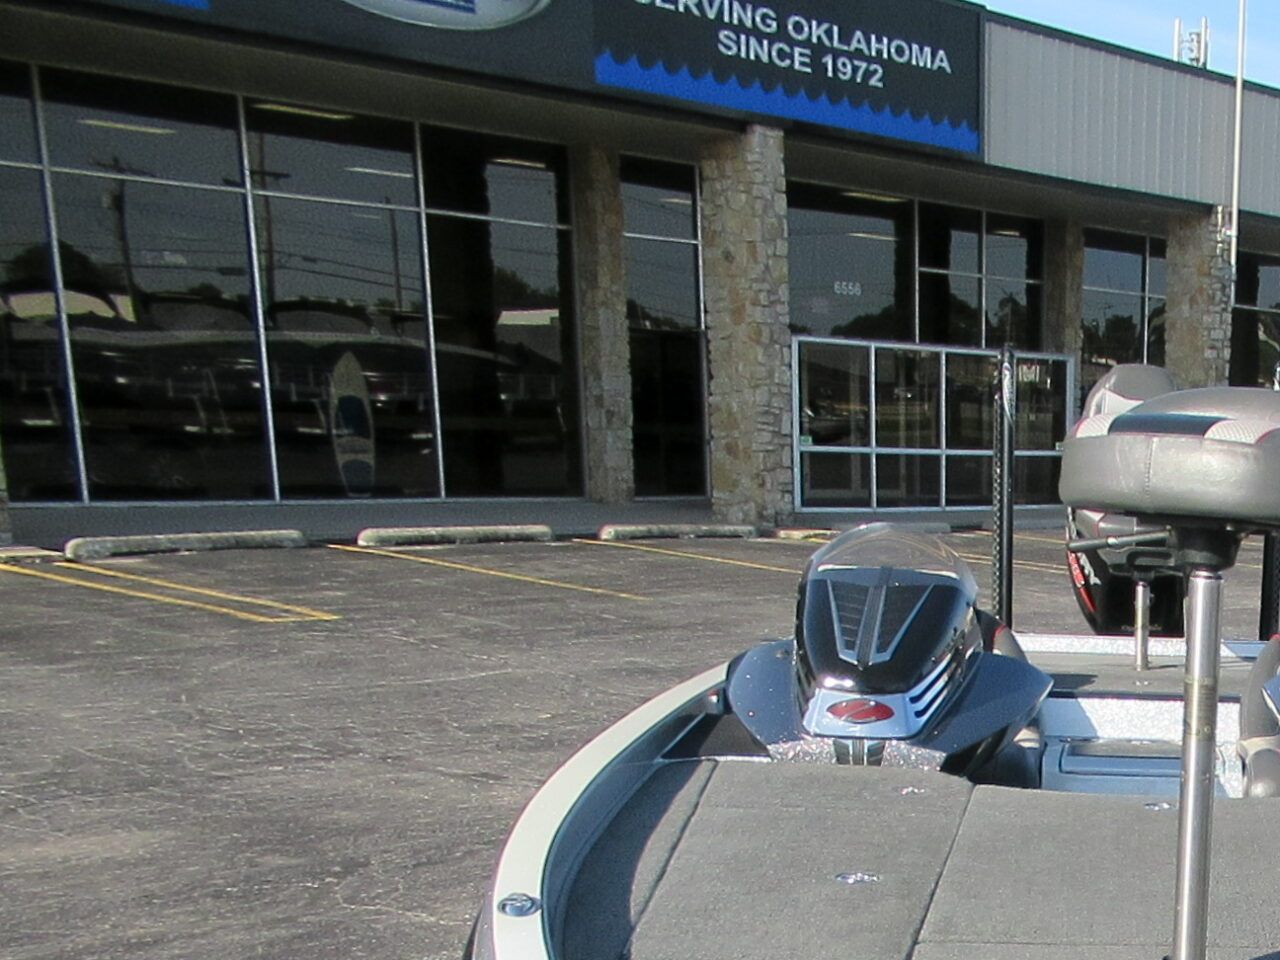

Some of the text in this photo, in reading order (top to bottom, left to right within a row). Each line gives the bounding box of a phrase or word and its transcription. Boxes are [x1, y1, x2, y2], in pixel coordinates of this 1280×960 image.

[634, 0, 952, 74] RVING OKLAHOMA
[717, 29, 884, 88] SINCE 1972
